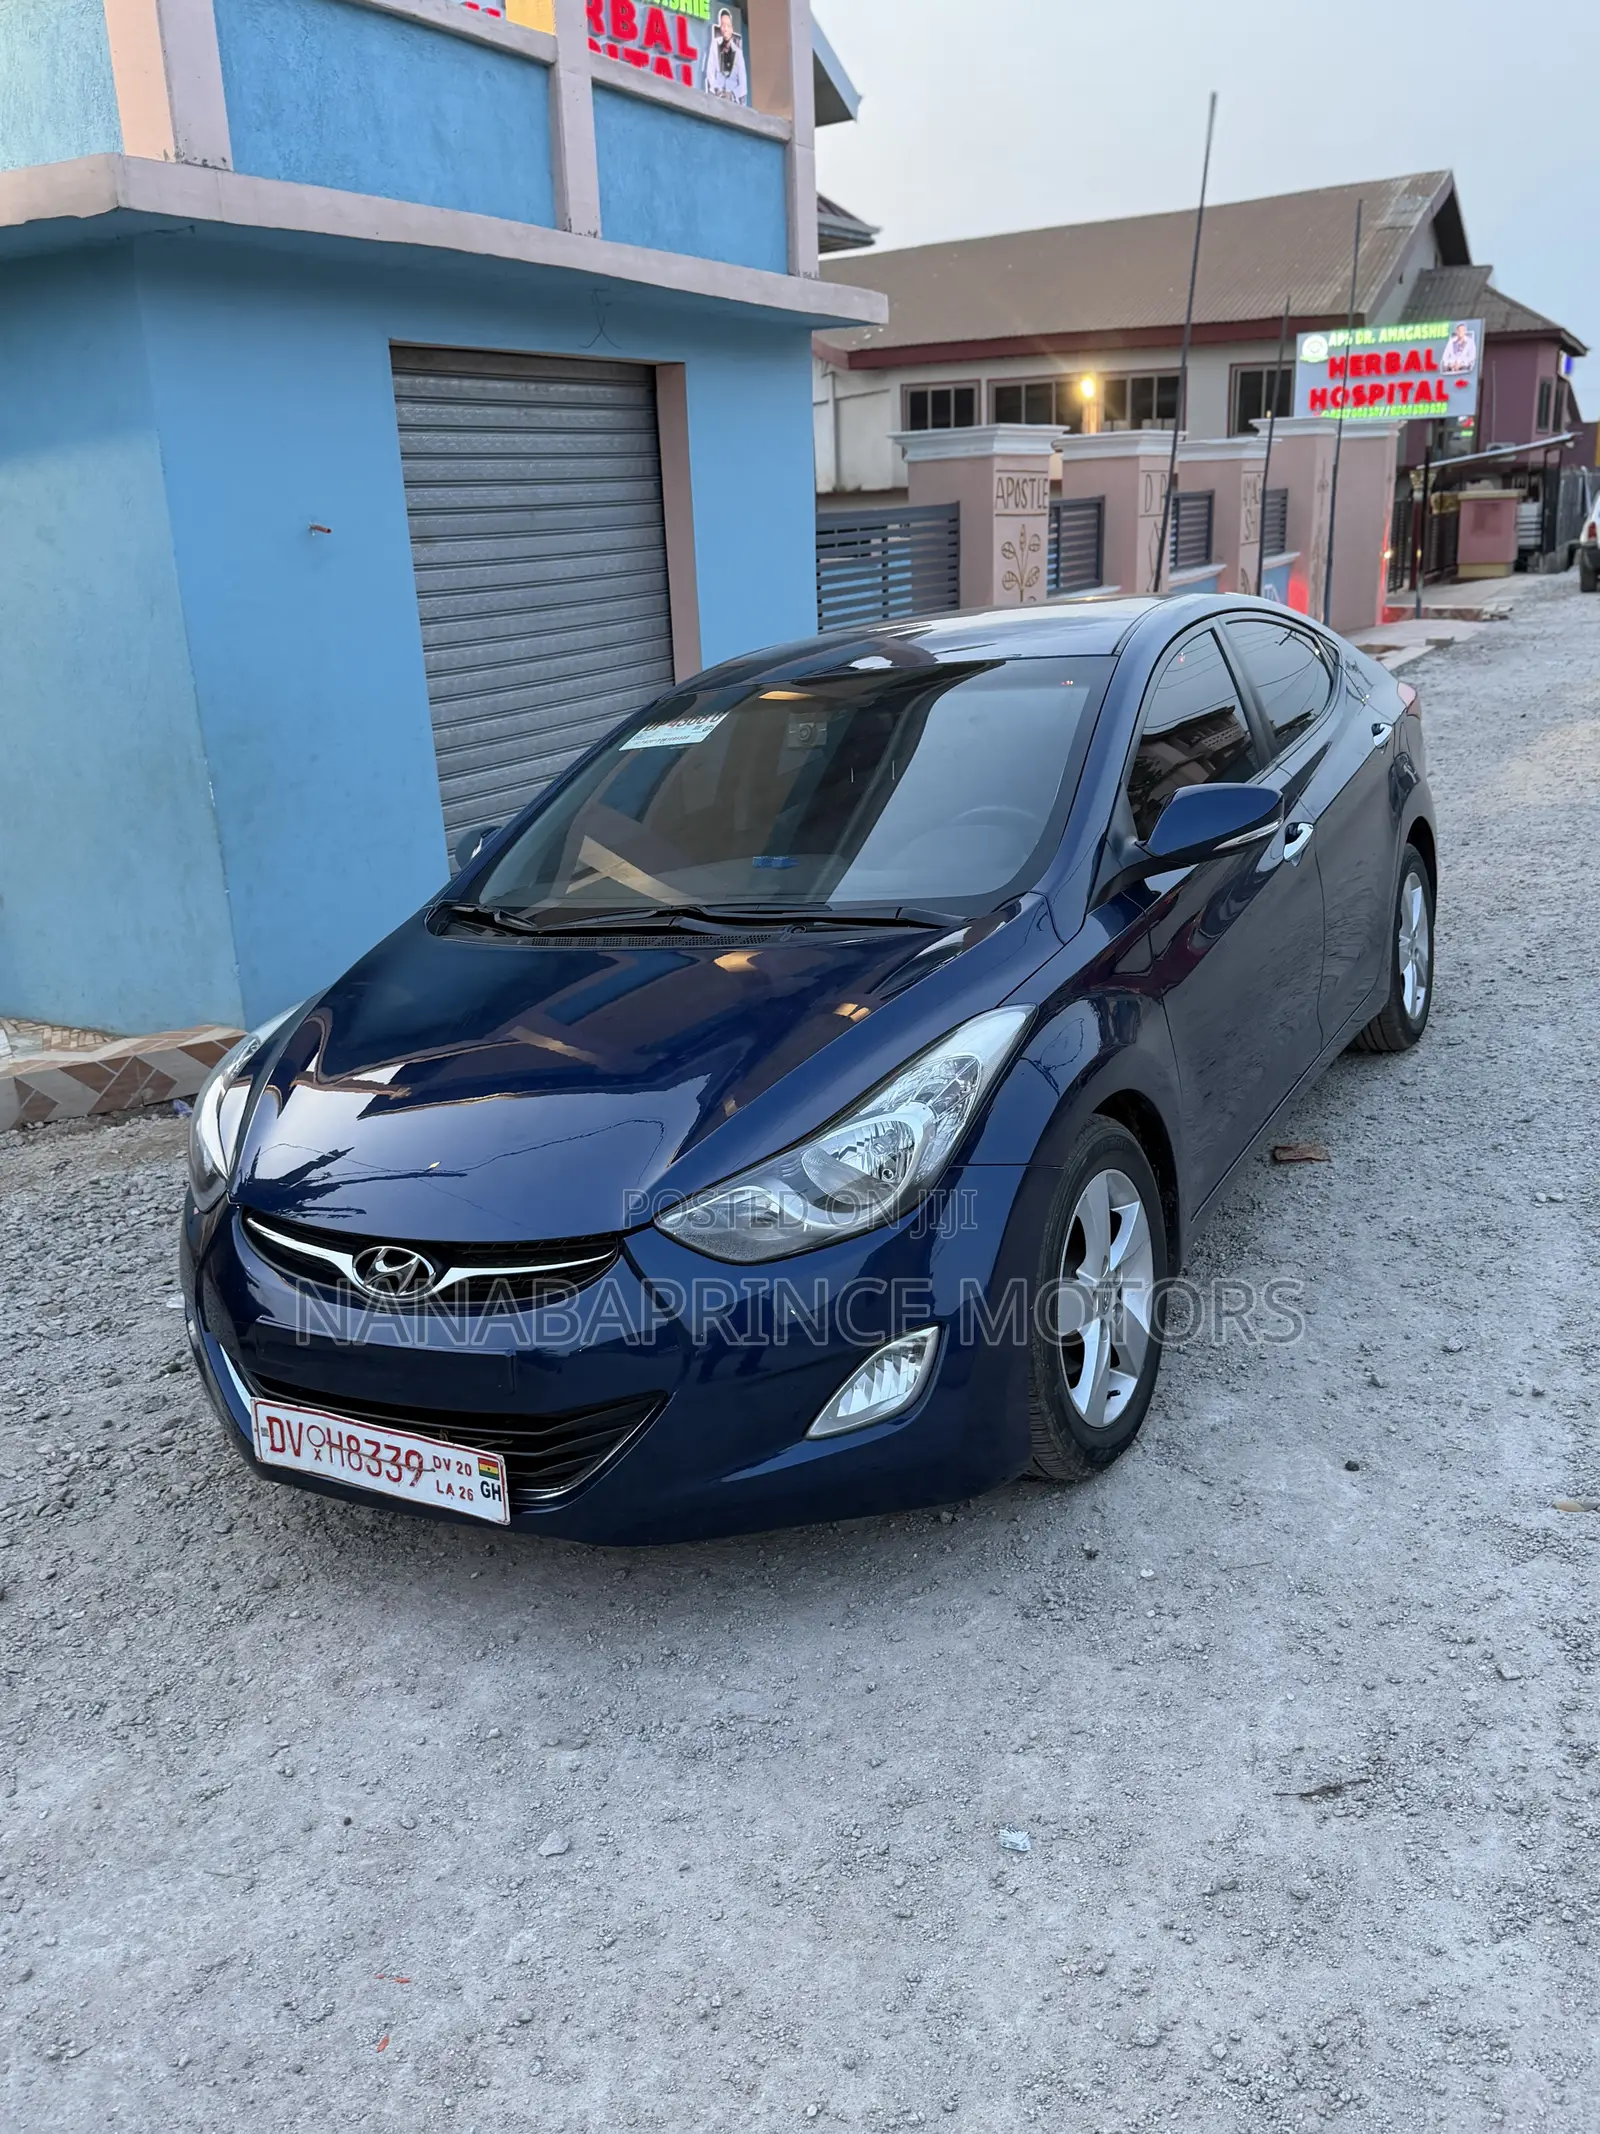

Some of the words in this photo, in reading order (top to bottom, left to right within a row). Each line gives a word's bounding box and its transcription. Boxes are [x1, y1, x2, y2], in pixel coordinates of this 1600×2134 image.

[1328, 349, 1439, 379] HERBAL
[1309, 380, 1449, 411] HOSPITAL
[995, 477, 1048, 509] APOSTLE
[266, 1416, 303, 1457] DV
[433, 1456, 451, 1472] DV
[456, 1461, 472, 1476] 20
[436, 1480, 455, 1496] LA
[459, 1486, 474, 1501] 26
[480, 1481, 502, 1502] GH
